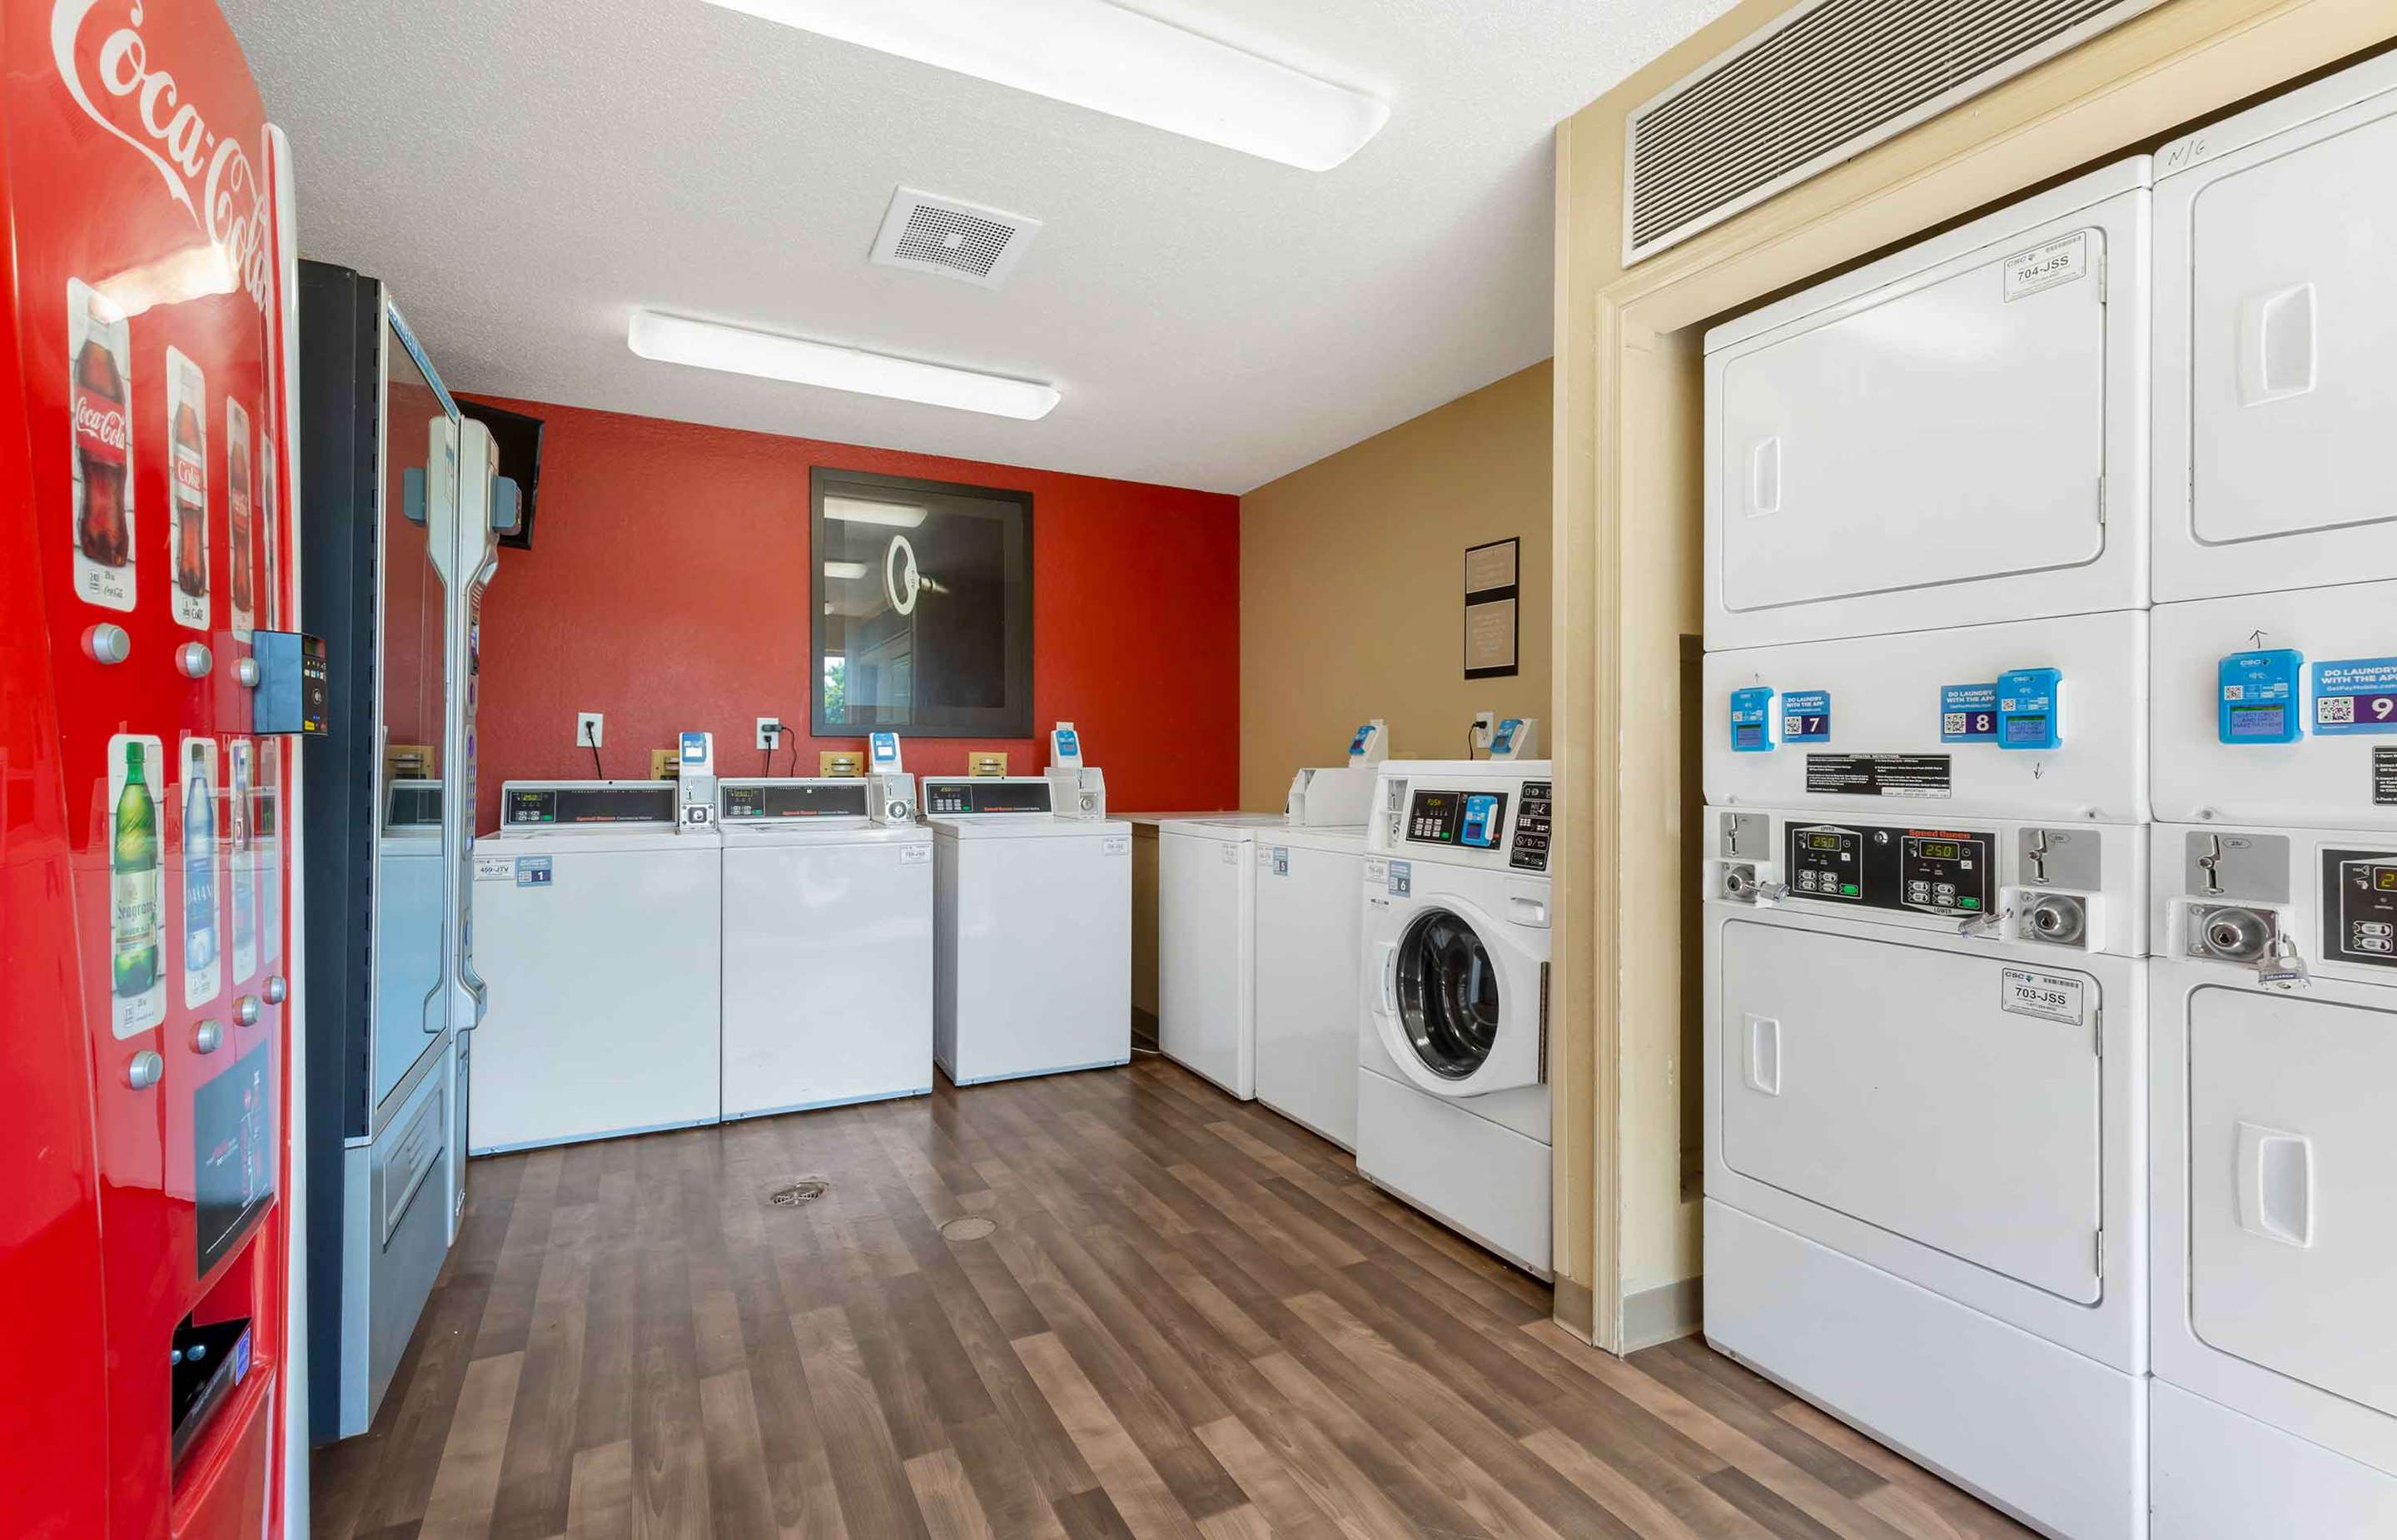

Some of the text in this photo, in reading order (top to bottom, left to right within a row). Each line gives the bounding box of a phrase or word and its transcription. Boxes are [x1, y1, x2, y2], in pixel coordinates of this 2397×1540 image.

[2017, 256, 2069, 281] 704-JSS
[76, 396, 124, 450] Coca-Cola
[178, 460, 201, 489] Coke
[2344, 666, 2397, 675] LAUNDRY
[2371, 698, 2394, 720] 9
[1809, 718, 1820, 733] 7
[1976, 714, 1990, 731] 8
[1908, 828, 1971, 839] Speed Queen
[1281, 862, 1286, 871] 5
[538, 871, 544, 881] 1
[1400, 880, 1406, 891] 6
[2016, 987, 2066, 1006] 703-JSS
